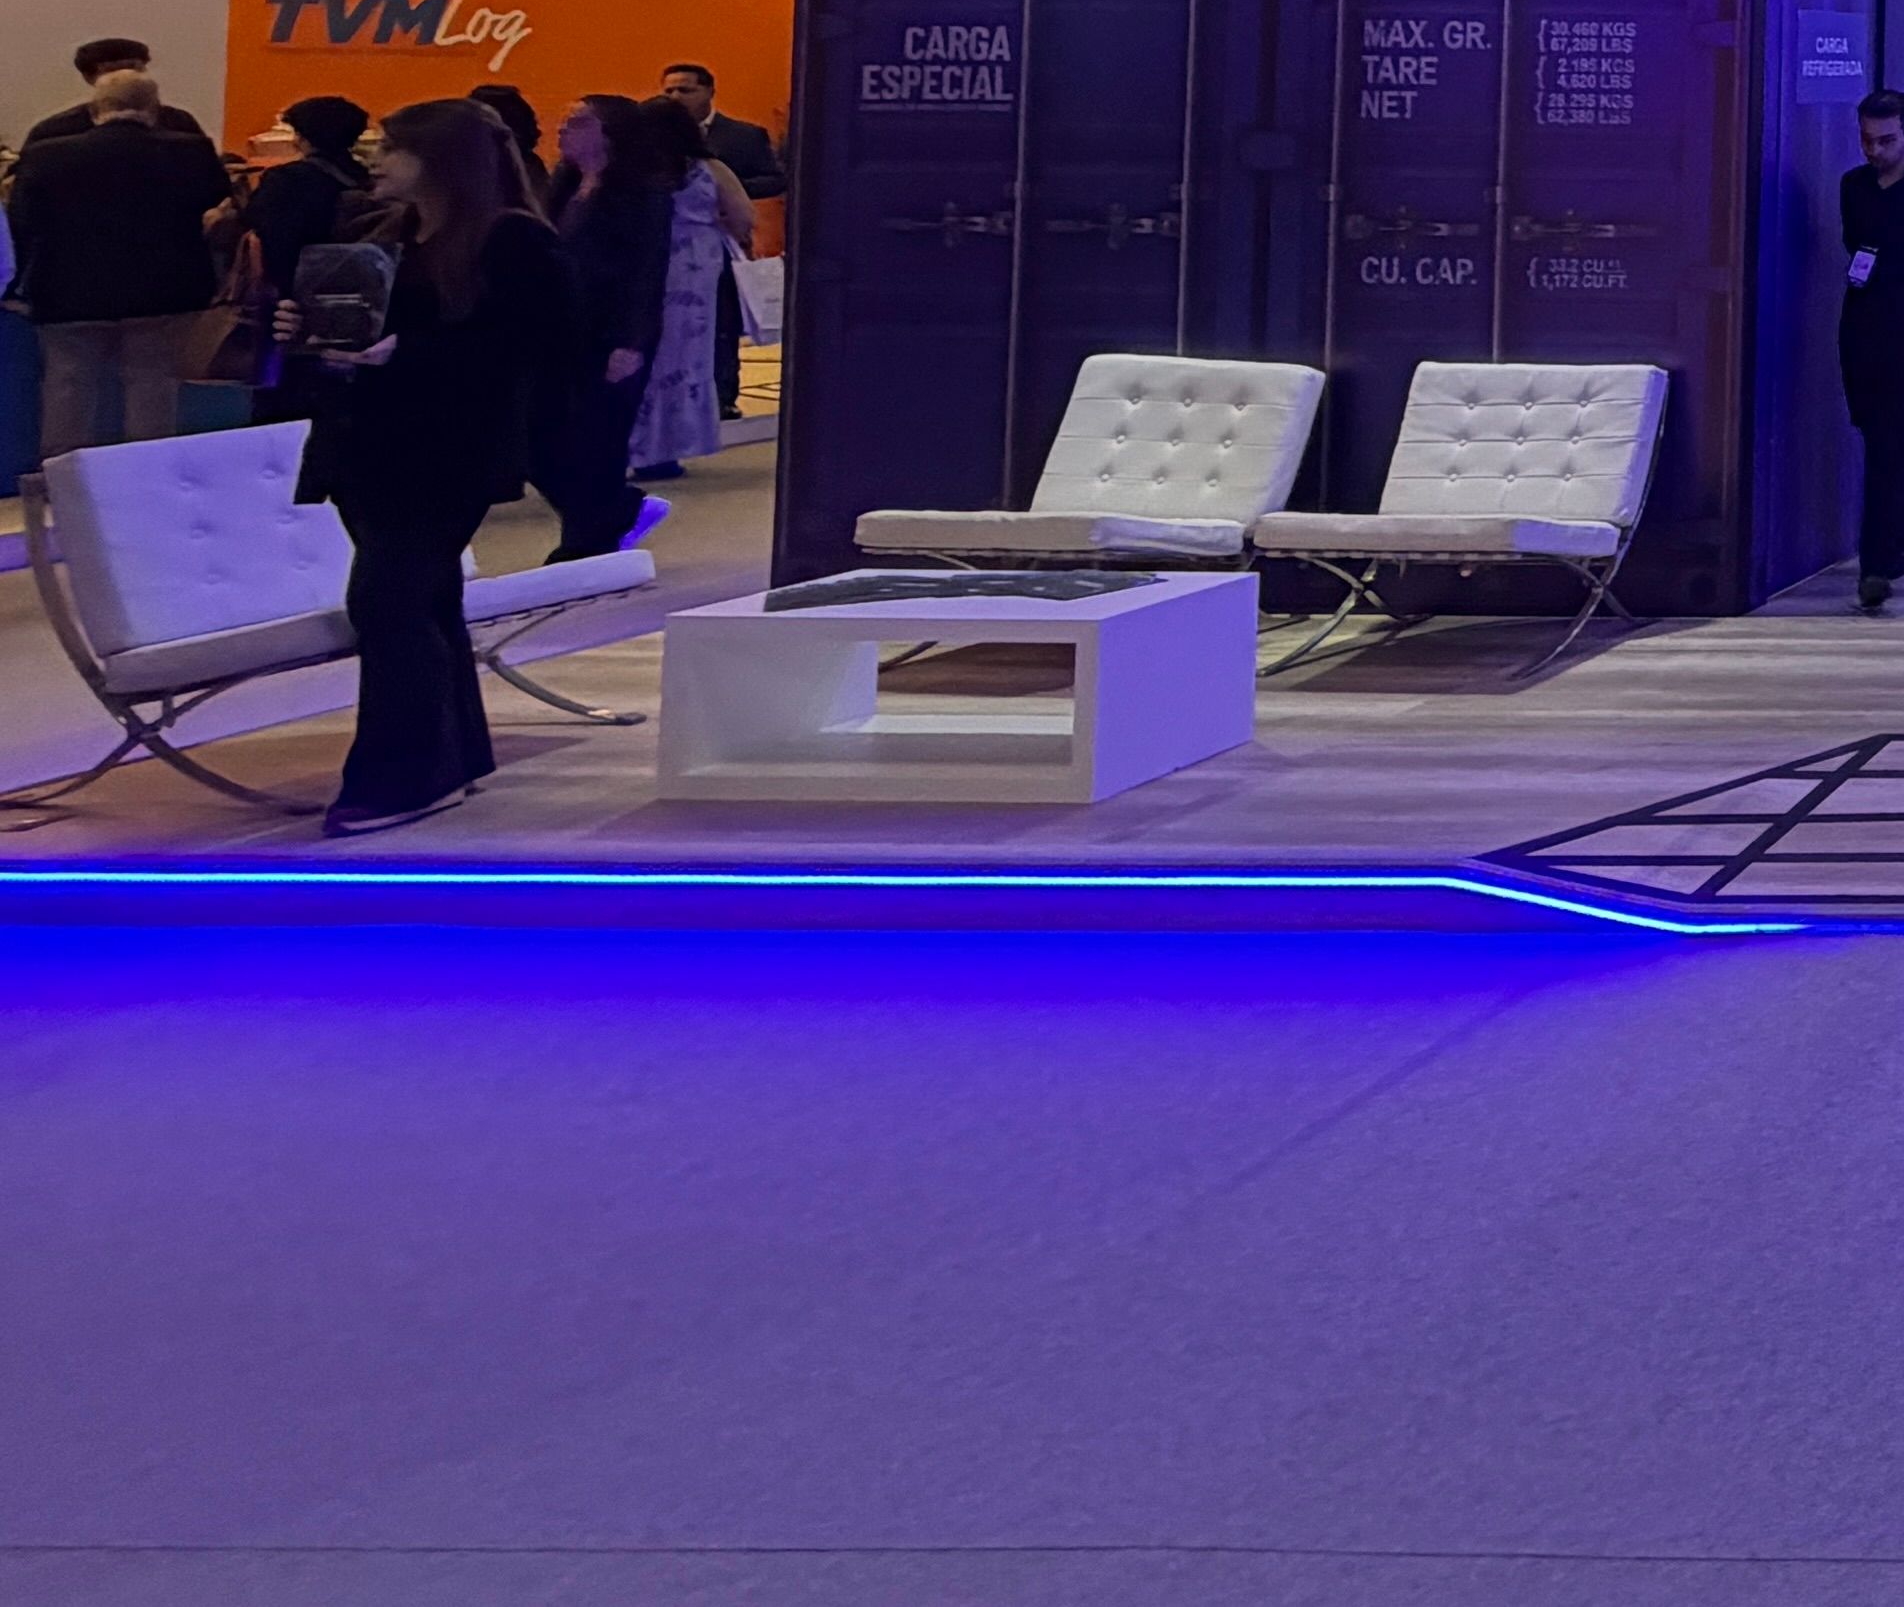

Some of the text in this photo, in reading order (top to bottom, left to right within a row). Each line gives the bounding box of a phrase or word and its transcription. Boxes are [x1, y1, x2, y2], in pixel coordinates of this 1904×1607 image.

[903, 25, 1012, 62] CARGA
[1363, 19, 1435, 49] MAX.
[1442, 20, 1492, 50] GR.
[860, 64, 1014, 101] ESPECIAL
[1361, 55, 1439, 85] TARE
[1360, 90, 1419, 119] NET
[1360, 256, 1408, 285] CU.
[1415, 257, 1478, 285] CAP.
